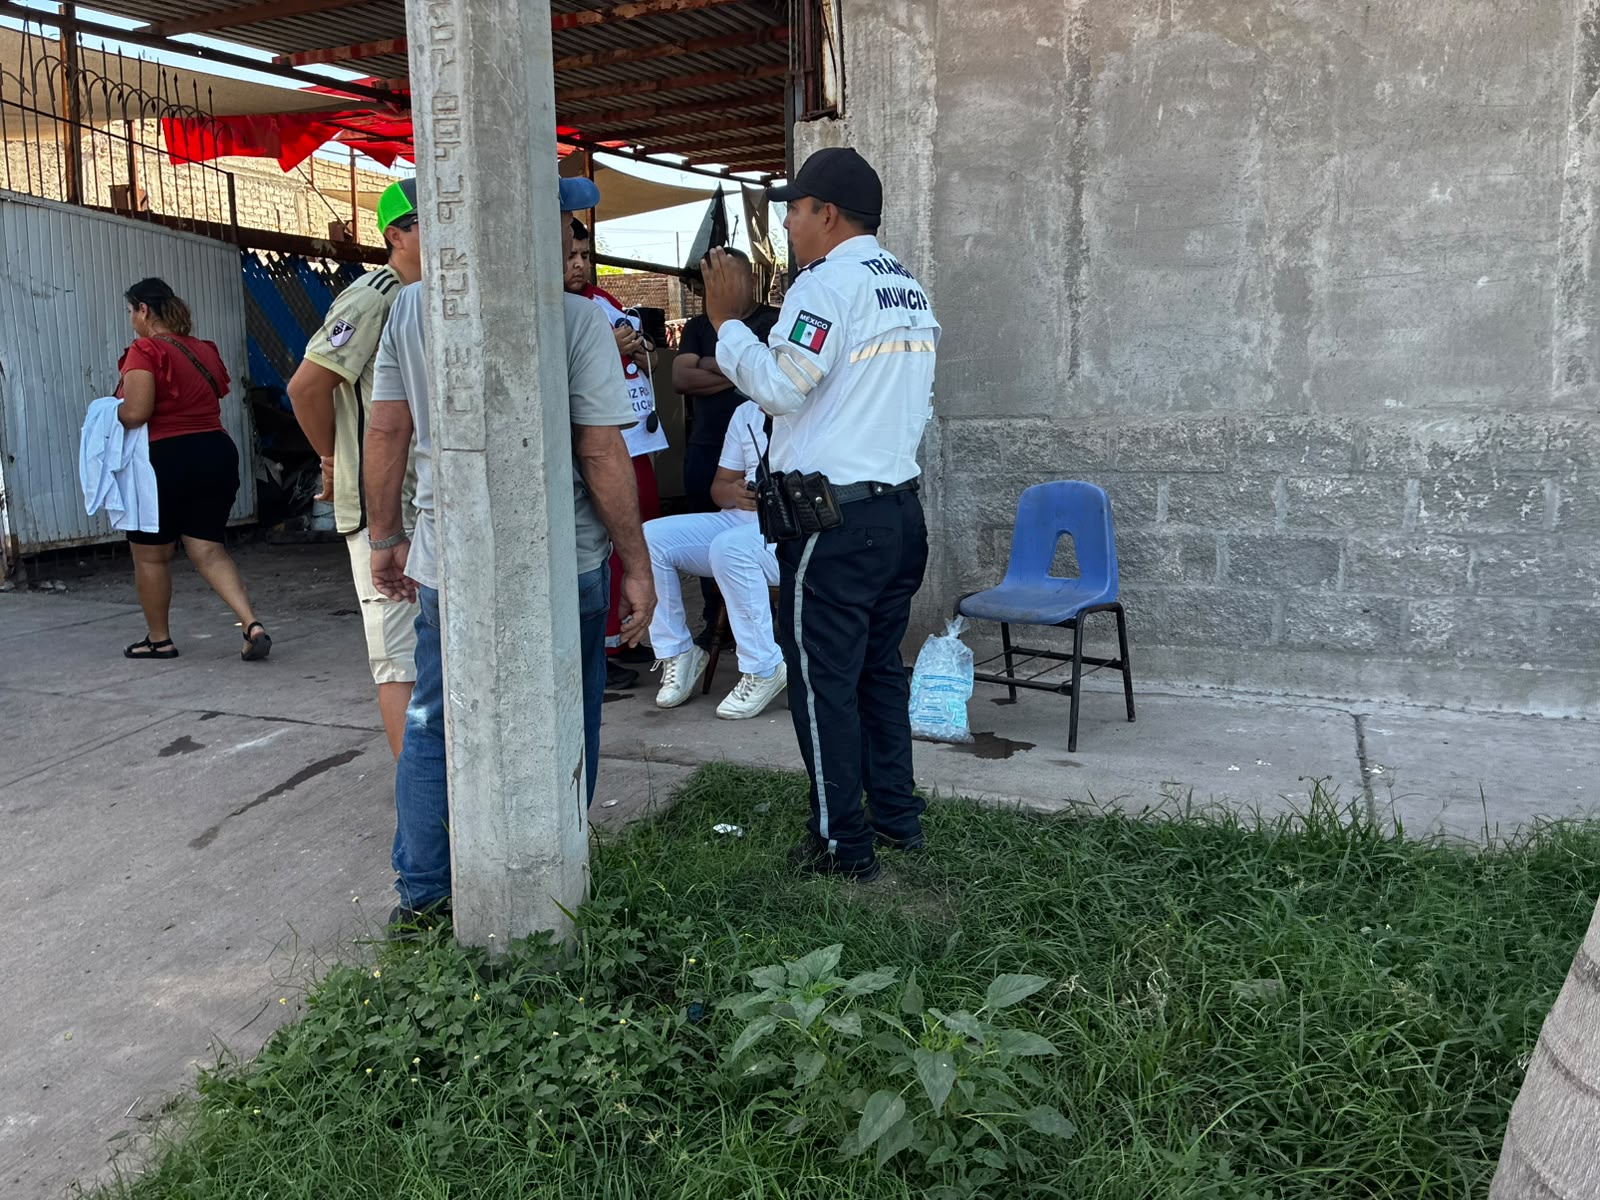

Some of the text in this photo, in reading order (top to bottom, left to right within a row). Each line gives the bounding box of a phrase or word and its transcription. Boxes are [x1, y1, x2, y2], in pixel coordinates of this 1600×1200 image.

[431, 94, 462, 162] 400
[439, 247, 470, 321] PCR
[799, 313, 829, 330] MÉXICO
[445, 346, 474, 414] CFE
